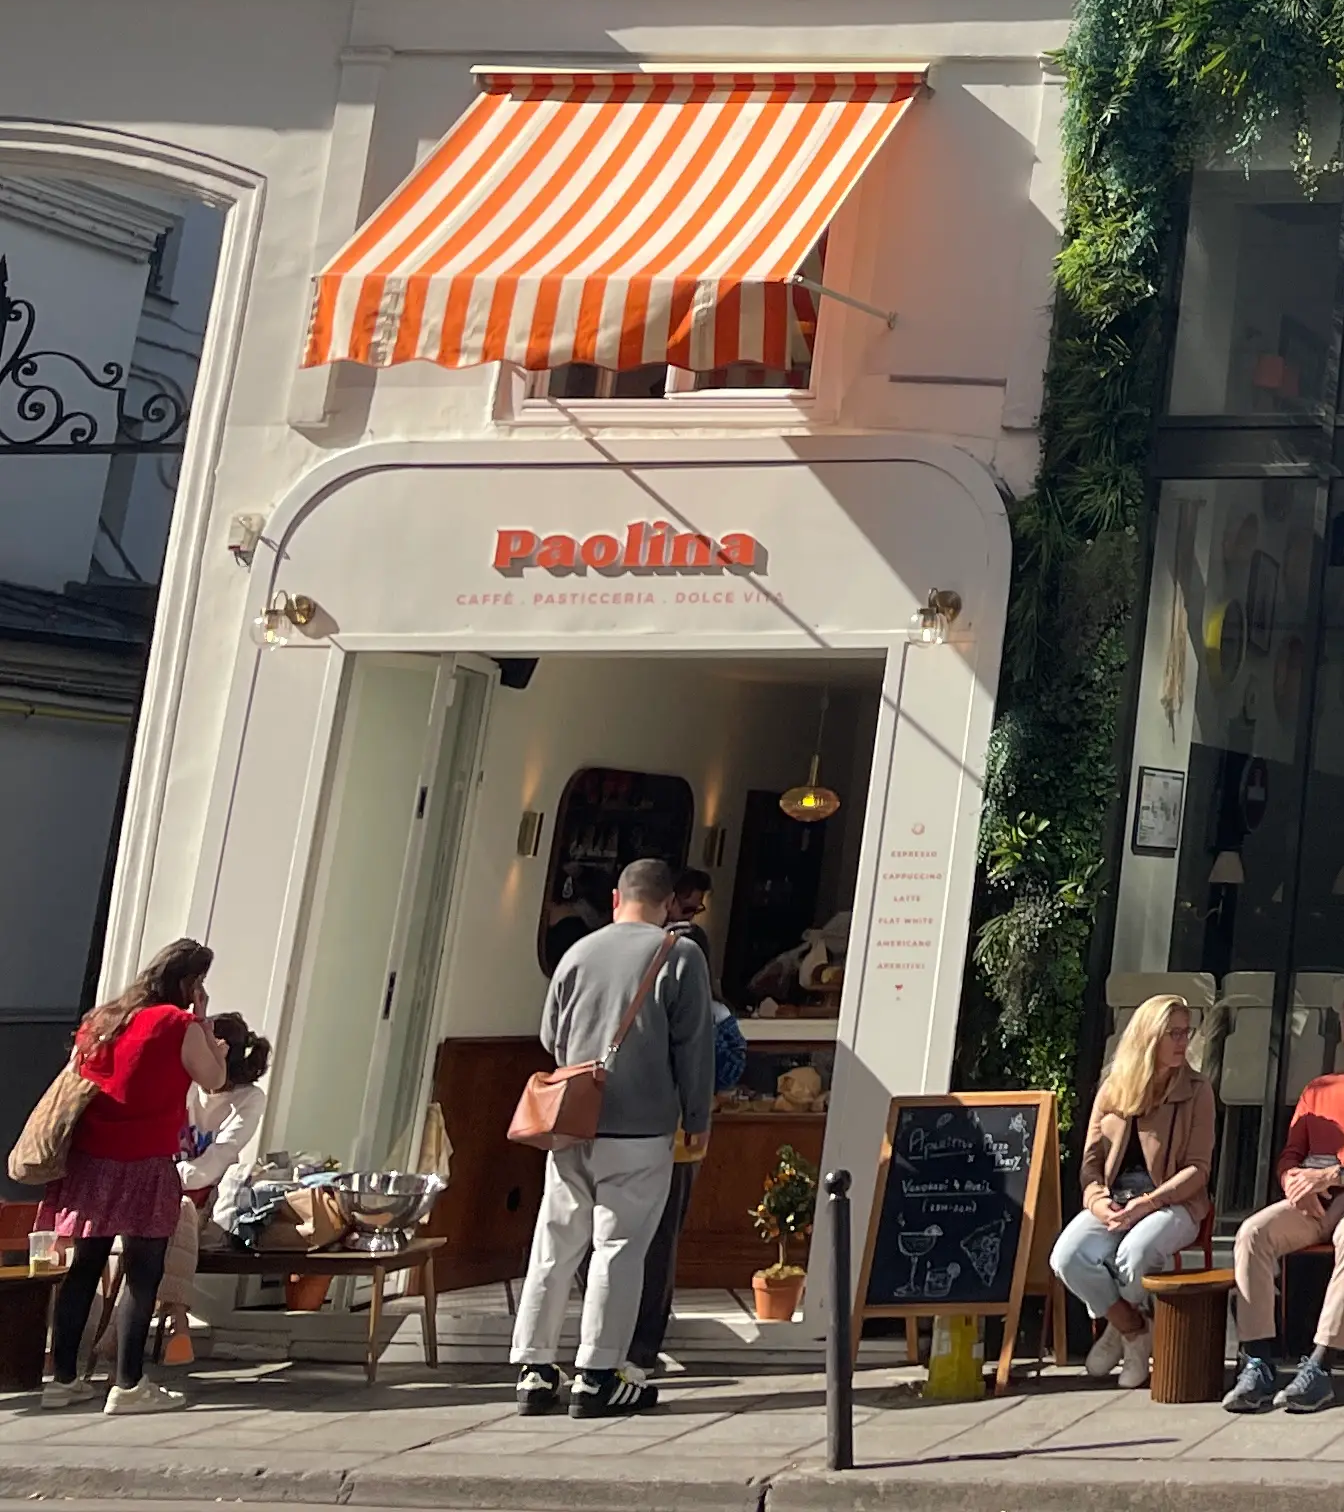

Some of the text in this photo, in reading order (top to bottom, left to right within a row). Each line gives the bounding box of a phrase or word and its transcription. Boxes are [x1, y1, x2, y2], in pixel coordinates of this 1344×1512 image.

[492, 519, 760, 571] Paolina
[533, 592, 655, 605] PASTICCERIA
[675, 591, 734, 604] DOLCE
[744, 591, 785, 604] VITA
[876, 940, 932, 948] AMERICANO
